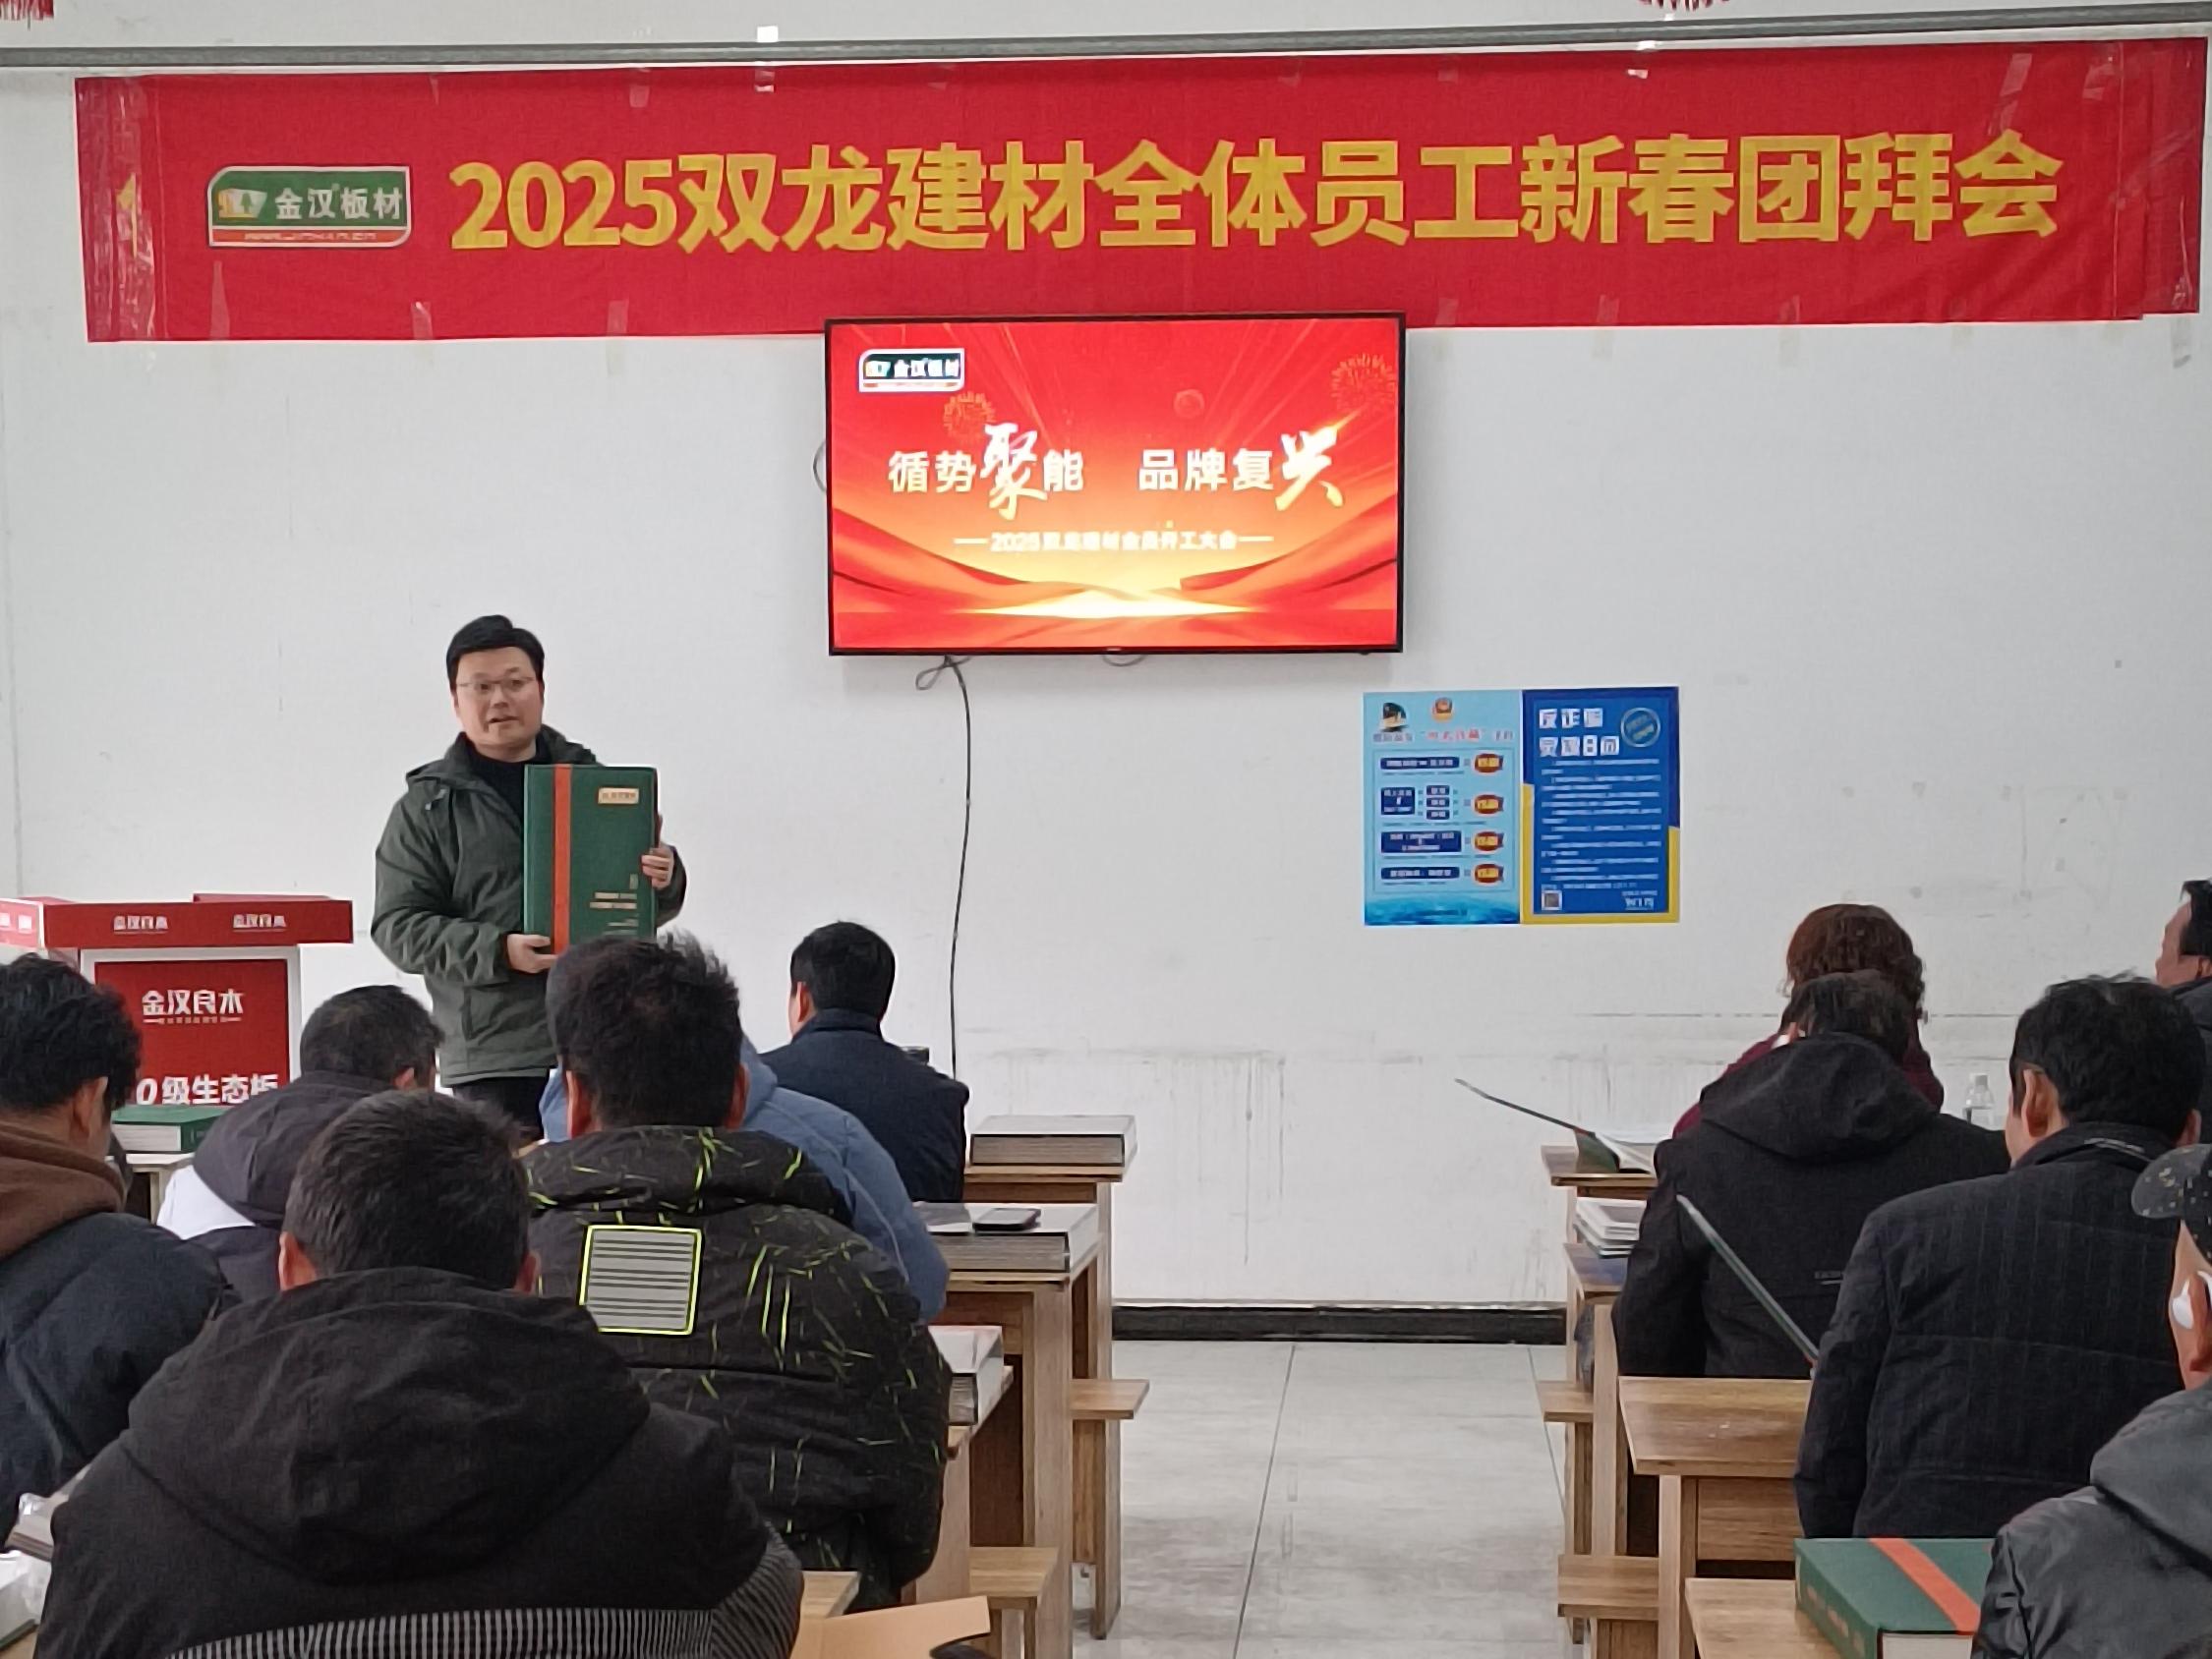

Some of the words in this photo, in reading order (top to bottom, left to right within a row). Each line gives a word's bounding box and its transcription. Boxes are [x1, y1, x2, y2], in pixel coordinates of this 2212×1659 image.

[274, 186, 403, 220] 金汉板材
[449, 129, 2063, 253] 2025双龙建材全体员工新春团拜会
[888, 423, 1084, 521] 循势聚能
[142, 988, 246, 1016] 金汉良木
